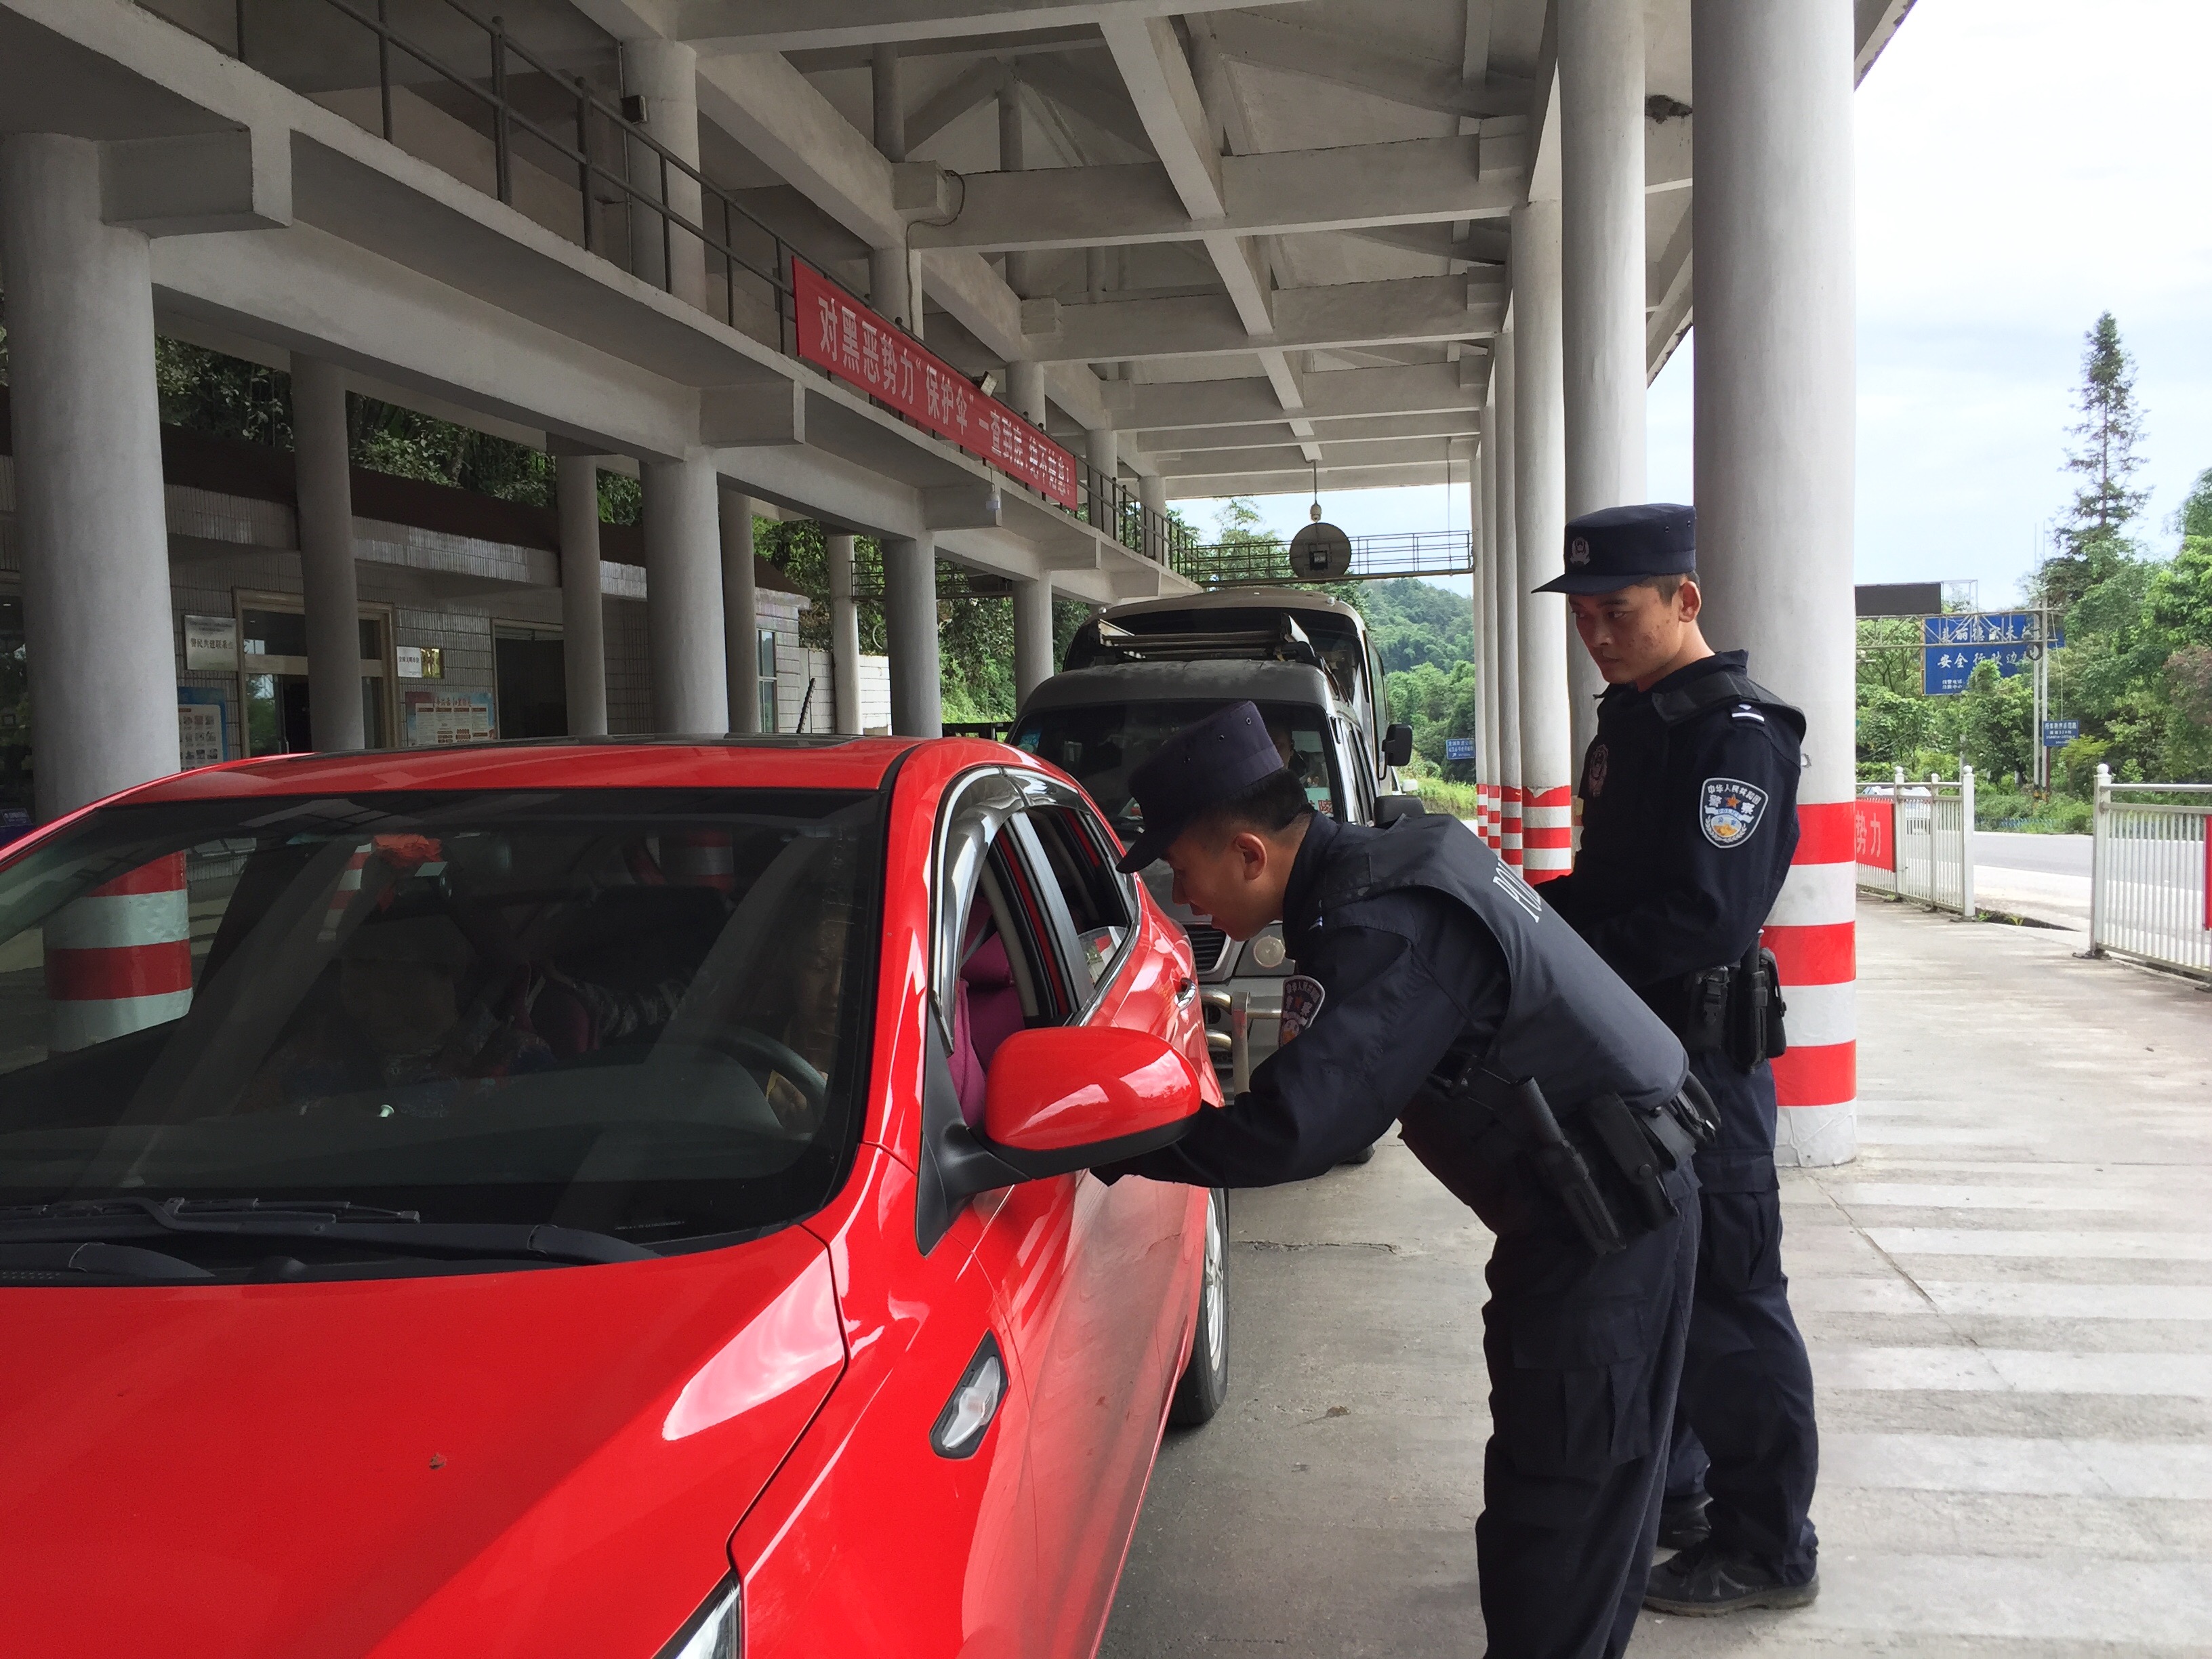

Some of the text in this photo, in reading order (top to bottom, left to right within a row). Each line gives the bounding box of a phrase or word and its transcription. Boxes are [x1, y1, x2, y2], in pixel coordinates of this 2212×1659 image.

[1707, 783, 1762, 805] 中华人民共和国
